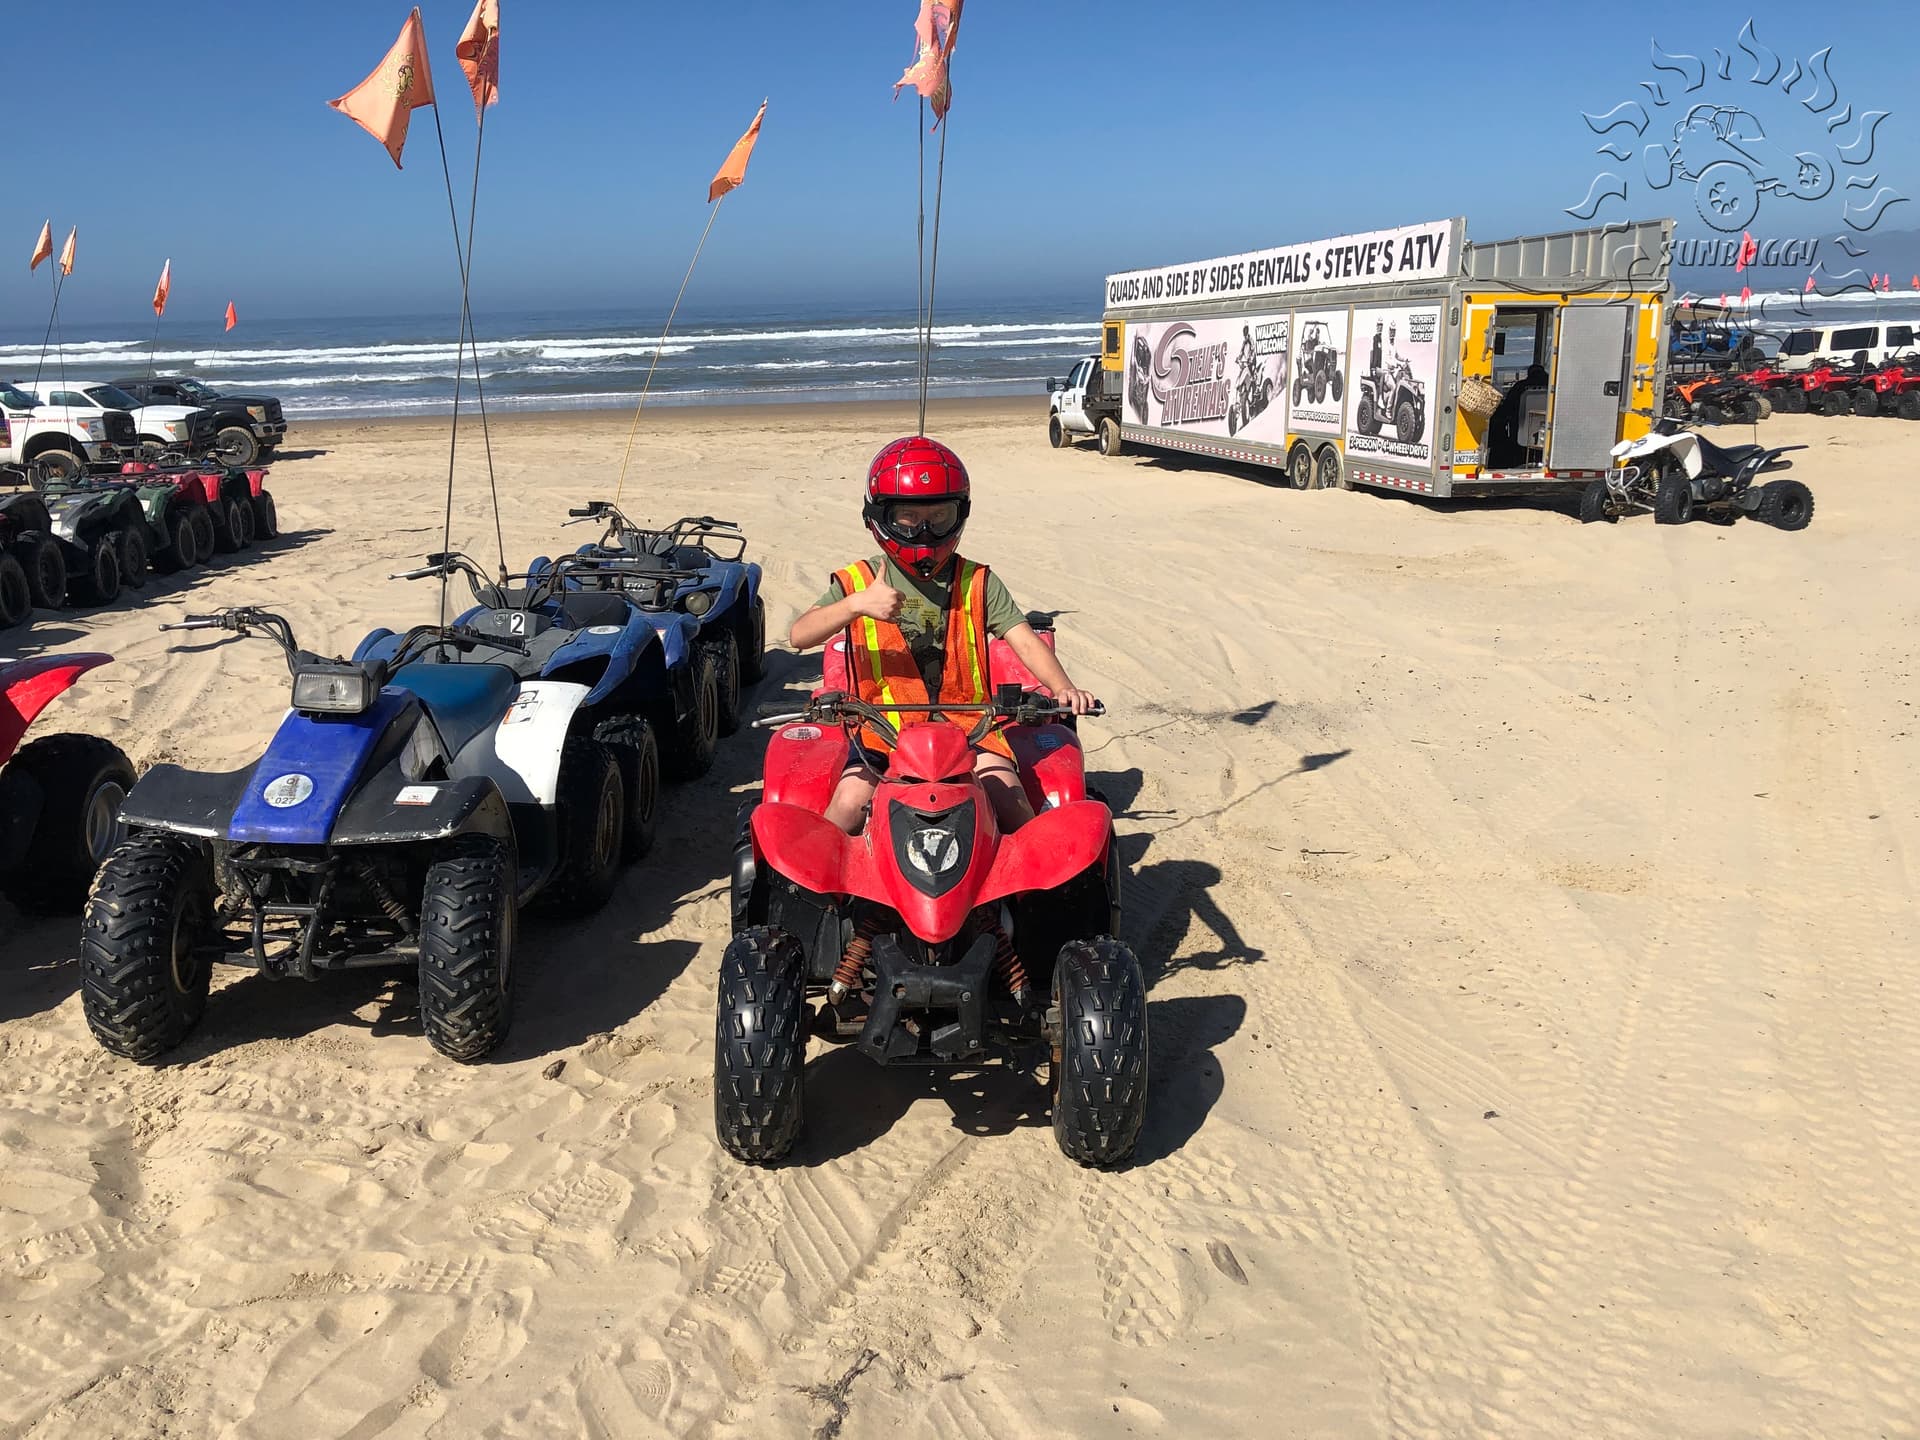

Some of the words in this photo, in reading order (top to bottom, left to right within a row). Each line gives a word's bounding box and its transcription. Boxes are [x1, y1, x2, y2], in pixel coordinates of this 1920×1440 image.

[1110, 278, 1140, 304] QUADS
[1141, 276, 1163, 299] AND
[1166, 272, 1190, 298] SIDE
[1192, 268, 1207, 295] BY
[1209, 262, 1244, 293] SIDES
[1248, 252, 1311, 288] RENTALS
[1323, 239, 1394, 280] STEVE'S
[1399, 232, 1444, 272] ATV
[1256, 337, 1287, 356] WELCOME
[1181, 379, 1231, 424] RENTALS
[1409, 444, 1429, 459] DRIVE
[511, 613, 524, 634] 2
[275, 797, 297, 805] 027
